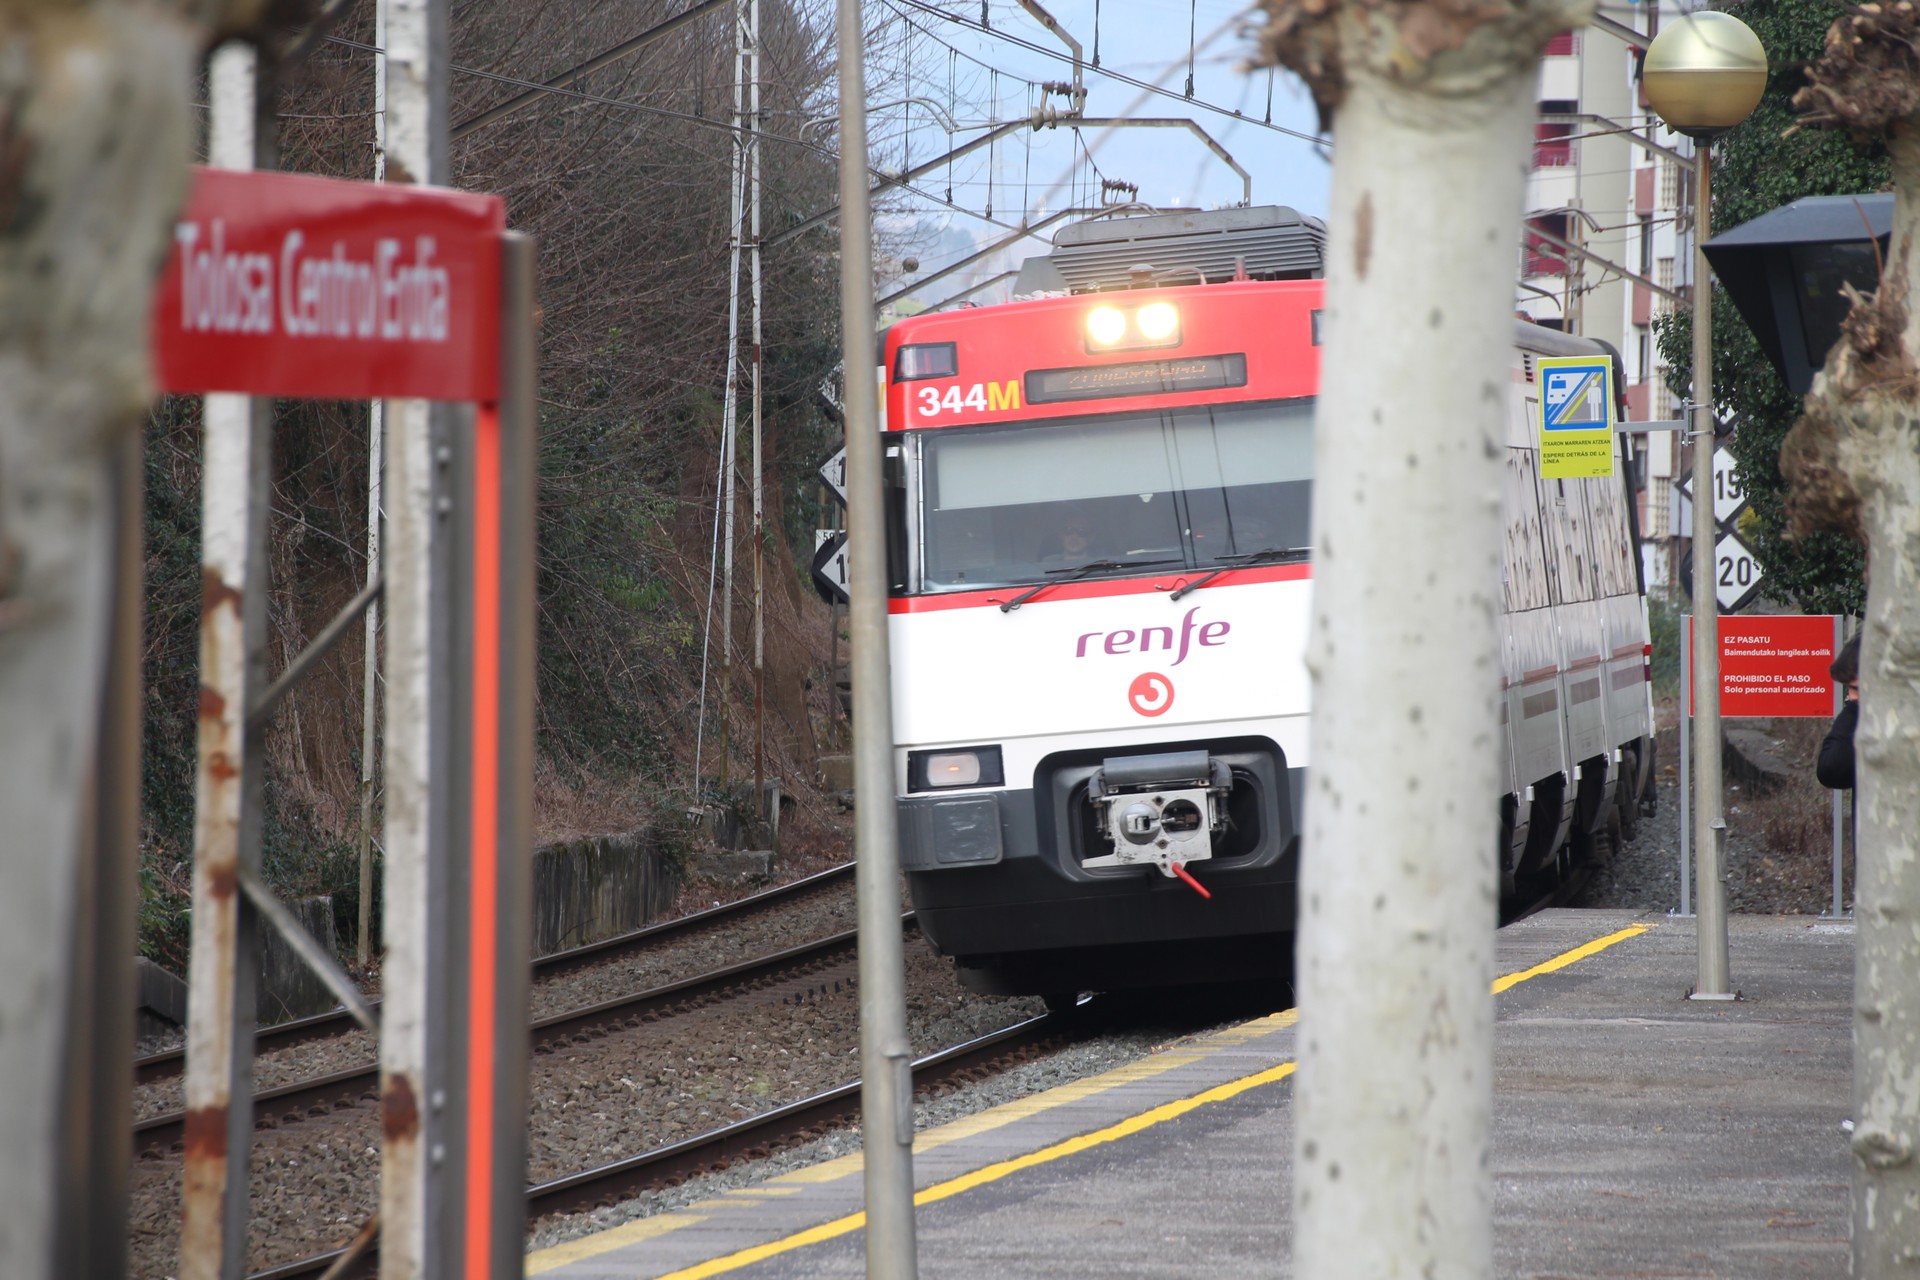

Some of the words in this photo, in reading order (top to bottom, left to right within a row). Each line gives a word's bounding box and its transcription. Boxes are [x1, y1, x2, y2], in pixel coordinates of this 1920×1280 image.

[175, 220, 273, 334] Tolosa
[917, 379, 1021, 417] 344M
[1719, 556, 1751, 587] 20
[1076, 606, 1231, 667] renfe
[1724, 636, 1735, 644] EZ
[1737, 636, 1771, 644] PASATU
[1777, 649, 1809, 658] langileak
[1724, 675, 1772, 683] PROHIBIDO
[1774, 675, 1785, 683] EL
[1787, 675, 1811, 683] PASO
[1745, 686, 1780, 694] personal
[1782, 686, 1826, 694] autorizado
